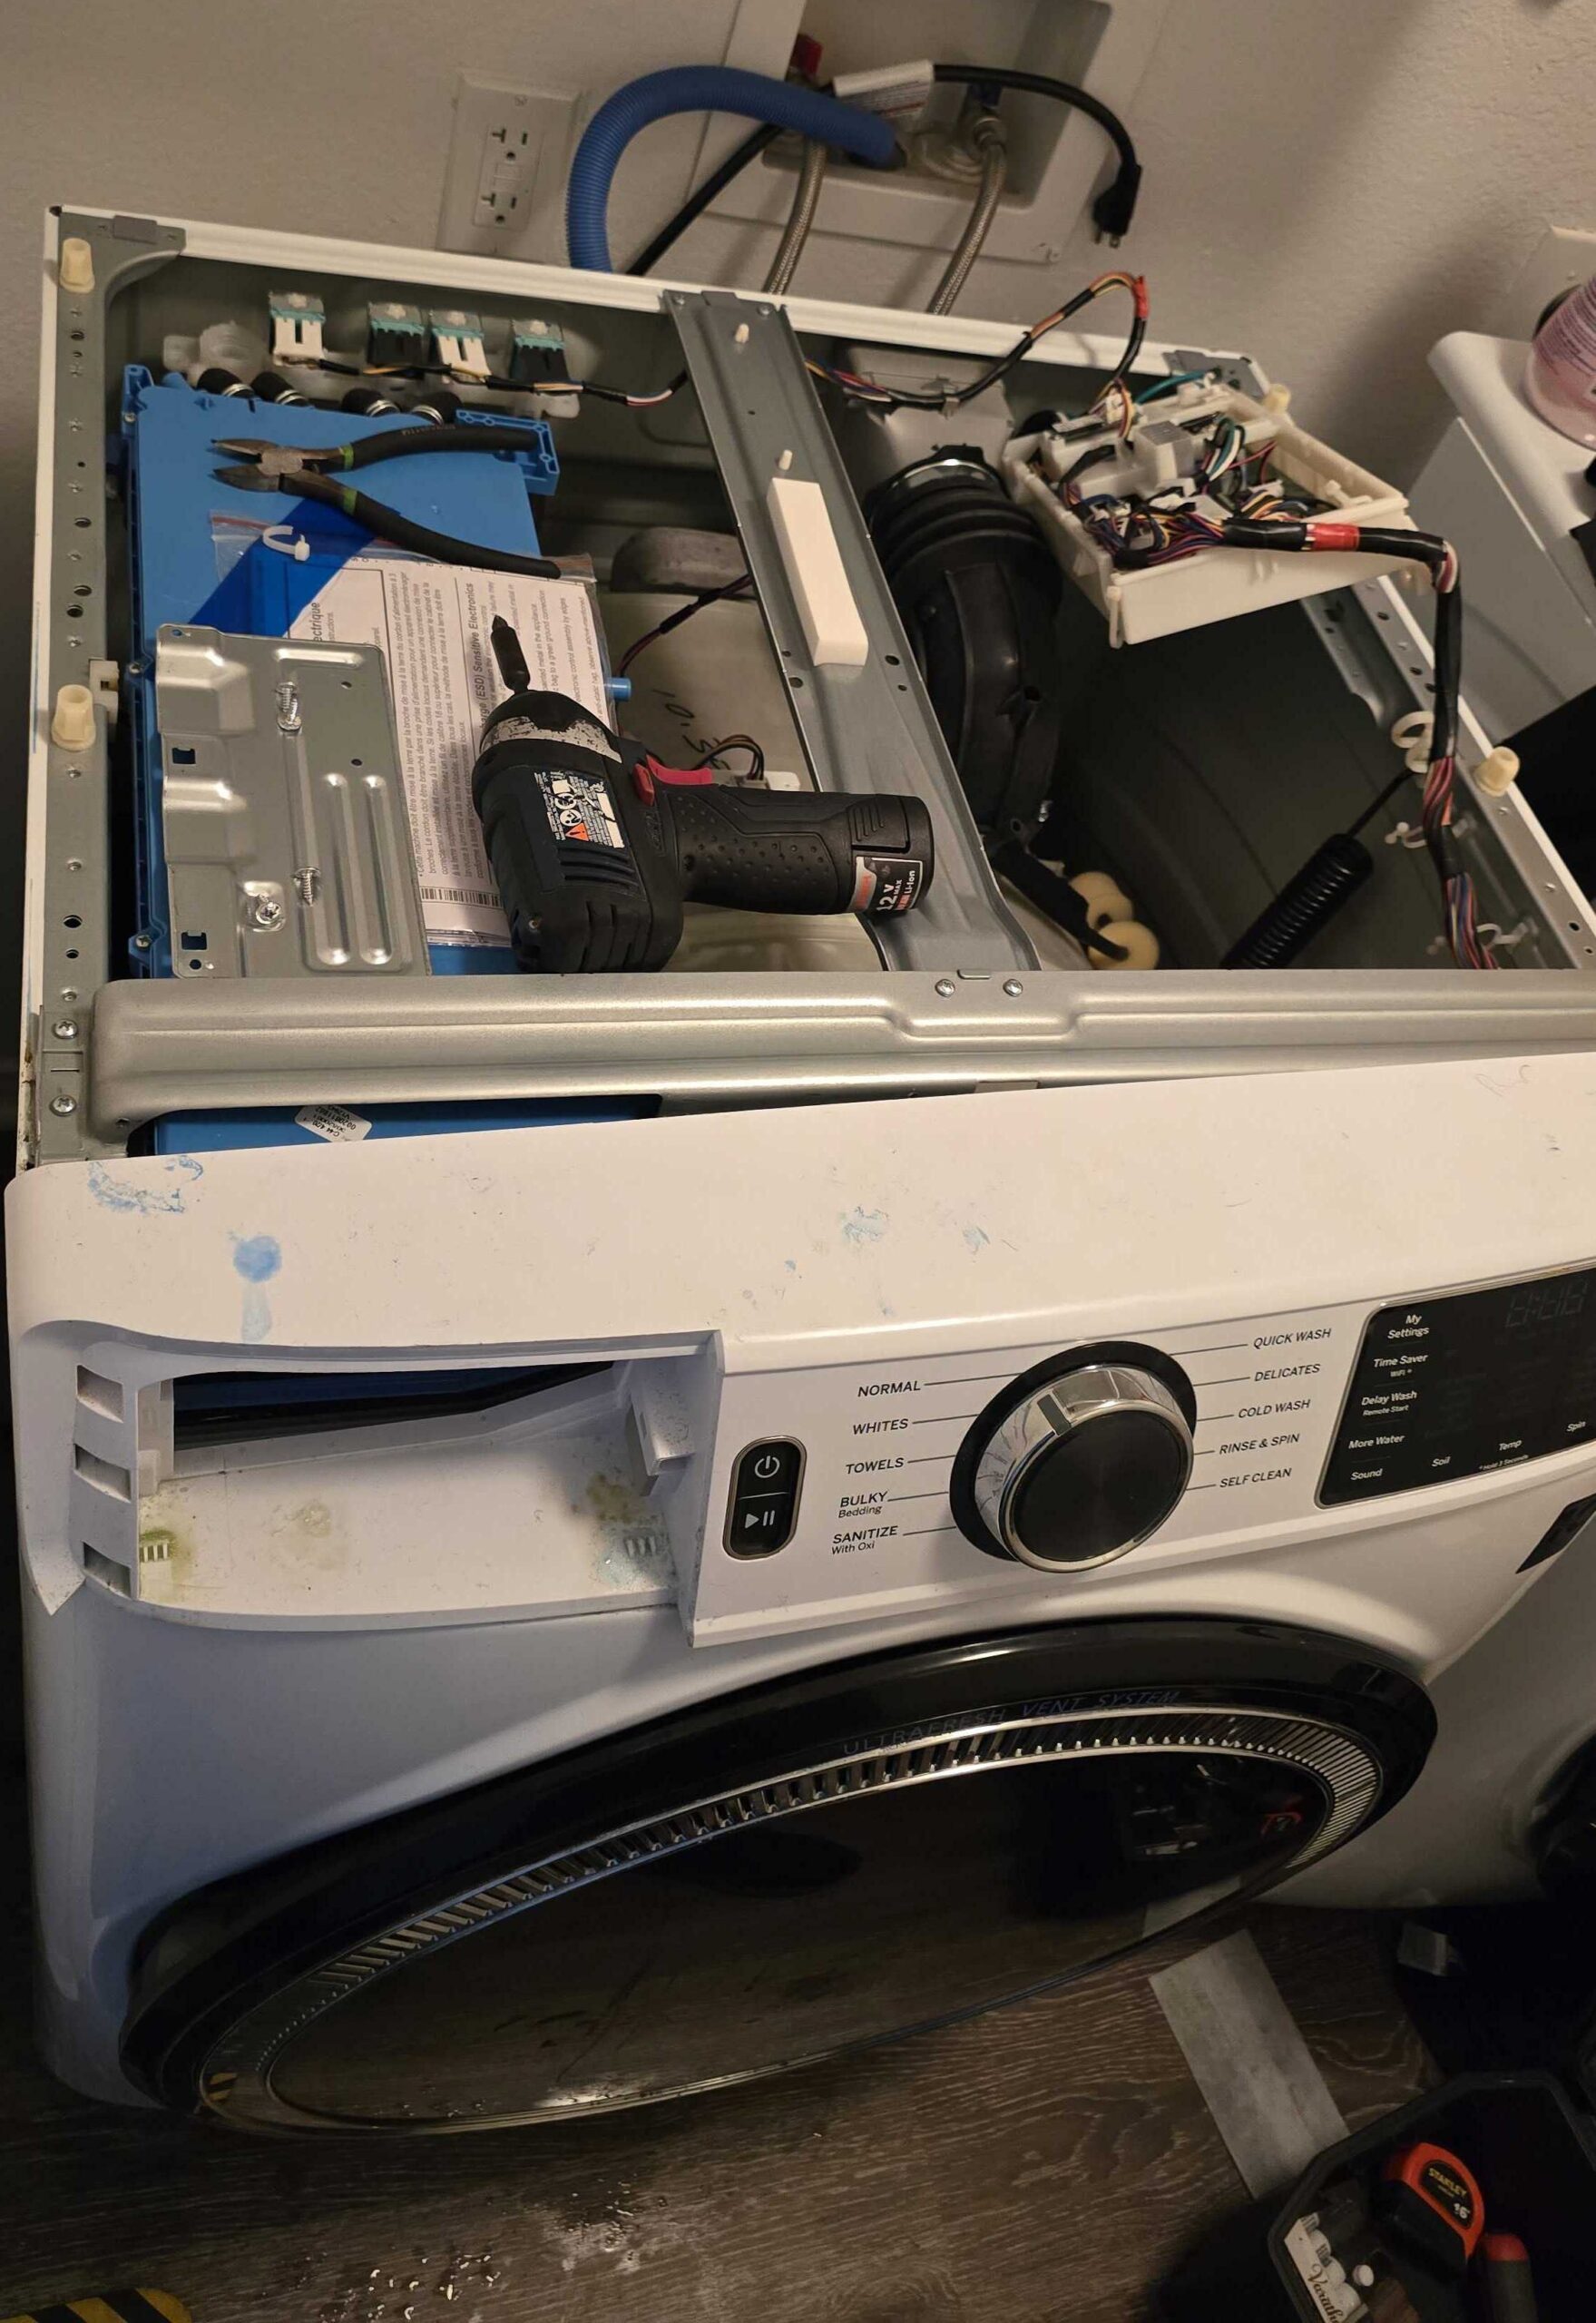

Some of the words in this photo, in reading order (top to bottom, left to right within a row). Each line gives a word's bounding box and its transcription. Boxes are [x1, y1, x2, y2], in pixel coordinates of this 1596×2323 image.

[466, 583, 478, 630] Electronics
[309, 602, 324, 642] ectrique
[328, 612, 336, 641] structions.
[472, 632, 483, 672] Sensitive
[475, 674, 486, 701] (ESD)
[1405, 1315, 1422, 1325] My
[1253, 1333, 1293, 1350] QUICK
[1295, 1328, 1331, 1344] WASH
[1387, 1327, 1430, 1339] Settings
[1374, 1358, 1397, 1367] Time
[1399, 1354, 1428, 1366] Saver
[1254, 1363, 1321, 1382] DELICATES
[857, 1379, 921, 1397] NORMAL
[1361, 1394, 1389, 1407] Delay
[1390, 1390, 1417, 1401] Wash
[1238, 1403, 1273, 1419] COLD
[1274, 1398, 1311, 1415] WASH
[1362, 1407, 1389, 1416] Remote
[1390, 1404, 1409, 1413] Start
[852, 1417, 909, 1436] WHITES
[1566, 1420, 1586, 1433] Spin
[1219, 1439, 1256, 1455] RINSE
[1258, 1437, 1268, 1450] &
[1270, 1433, 1300, 1448] SPIN
[1348, 1438, 1375, 1449] More
[1376, 1434, 1405, 1446] Water
[1498, 1439, 1522, 1452] Temp
[845, 1456, 905, 1475] TOWELS
[1432, 1456, 1451, 1467] Soil
[1219, 1474, 1249, 1488] SELF
[1250, 1467, 1292, 1485] CLEAN
[1350, 1467, 1383, 1481] Sound
[840, 1490, 889, 1508] BULKY
[837, 1504, 882, 1520] Bedding
[832, 1524, 898, 1544] SANITIZE
[831, 1542, 857, 1554] With
[858, 1539, 876, 1552] Oxi
[1021, 1697, 1086, 1718] VENT
[1098, 1691, 1180, 1710] SYSTEM
